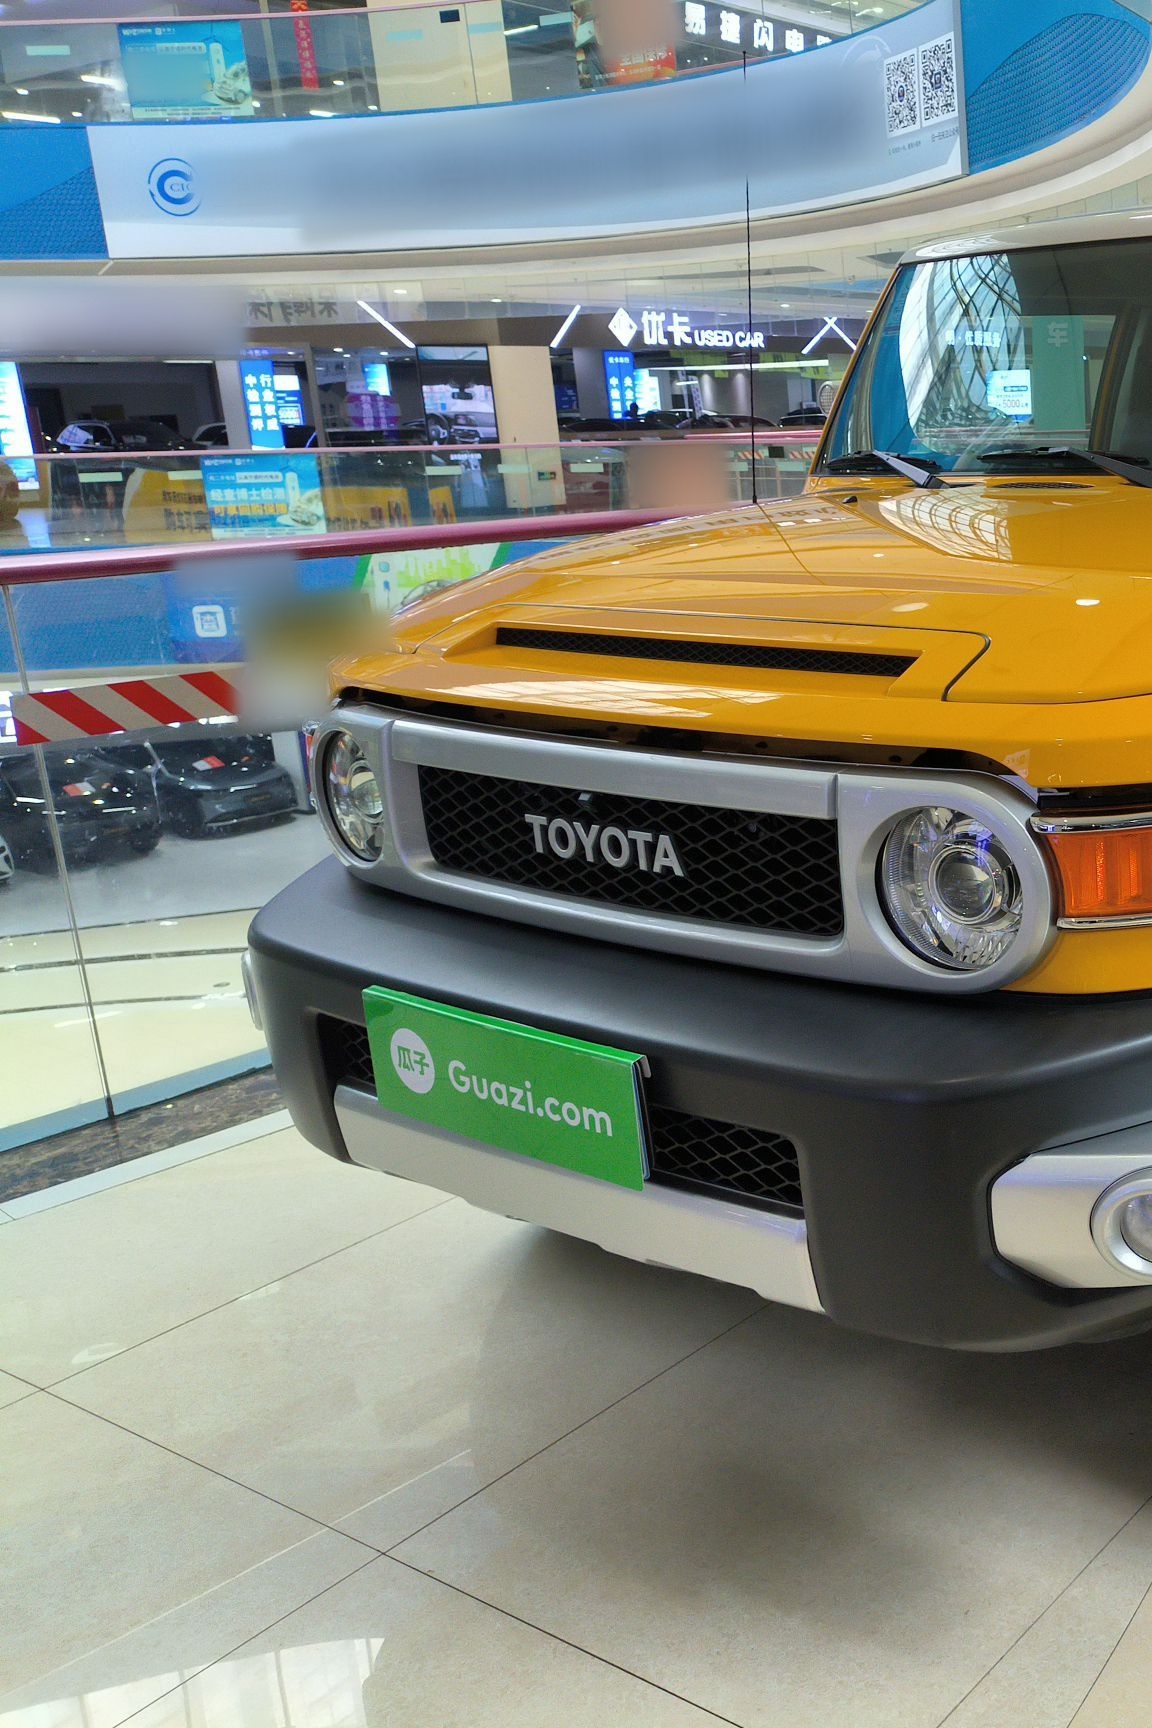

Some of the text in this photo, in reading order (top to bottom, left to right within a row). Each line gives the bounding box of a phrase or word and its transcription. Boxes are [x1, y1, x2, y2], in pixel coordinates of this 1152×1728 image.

[641, 310, 765, 348] 优卡 USED CAR
[524, 813, 685, 877] TOYOTA
[397, 1045, 613, 1137] 瓜子 Guazi.com
